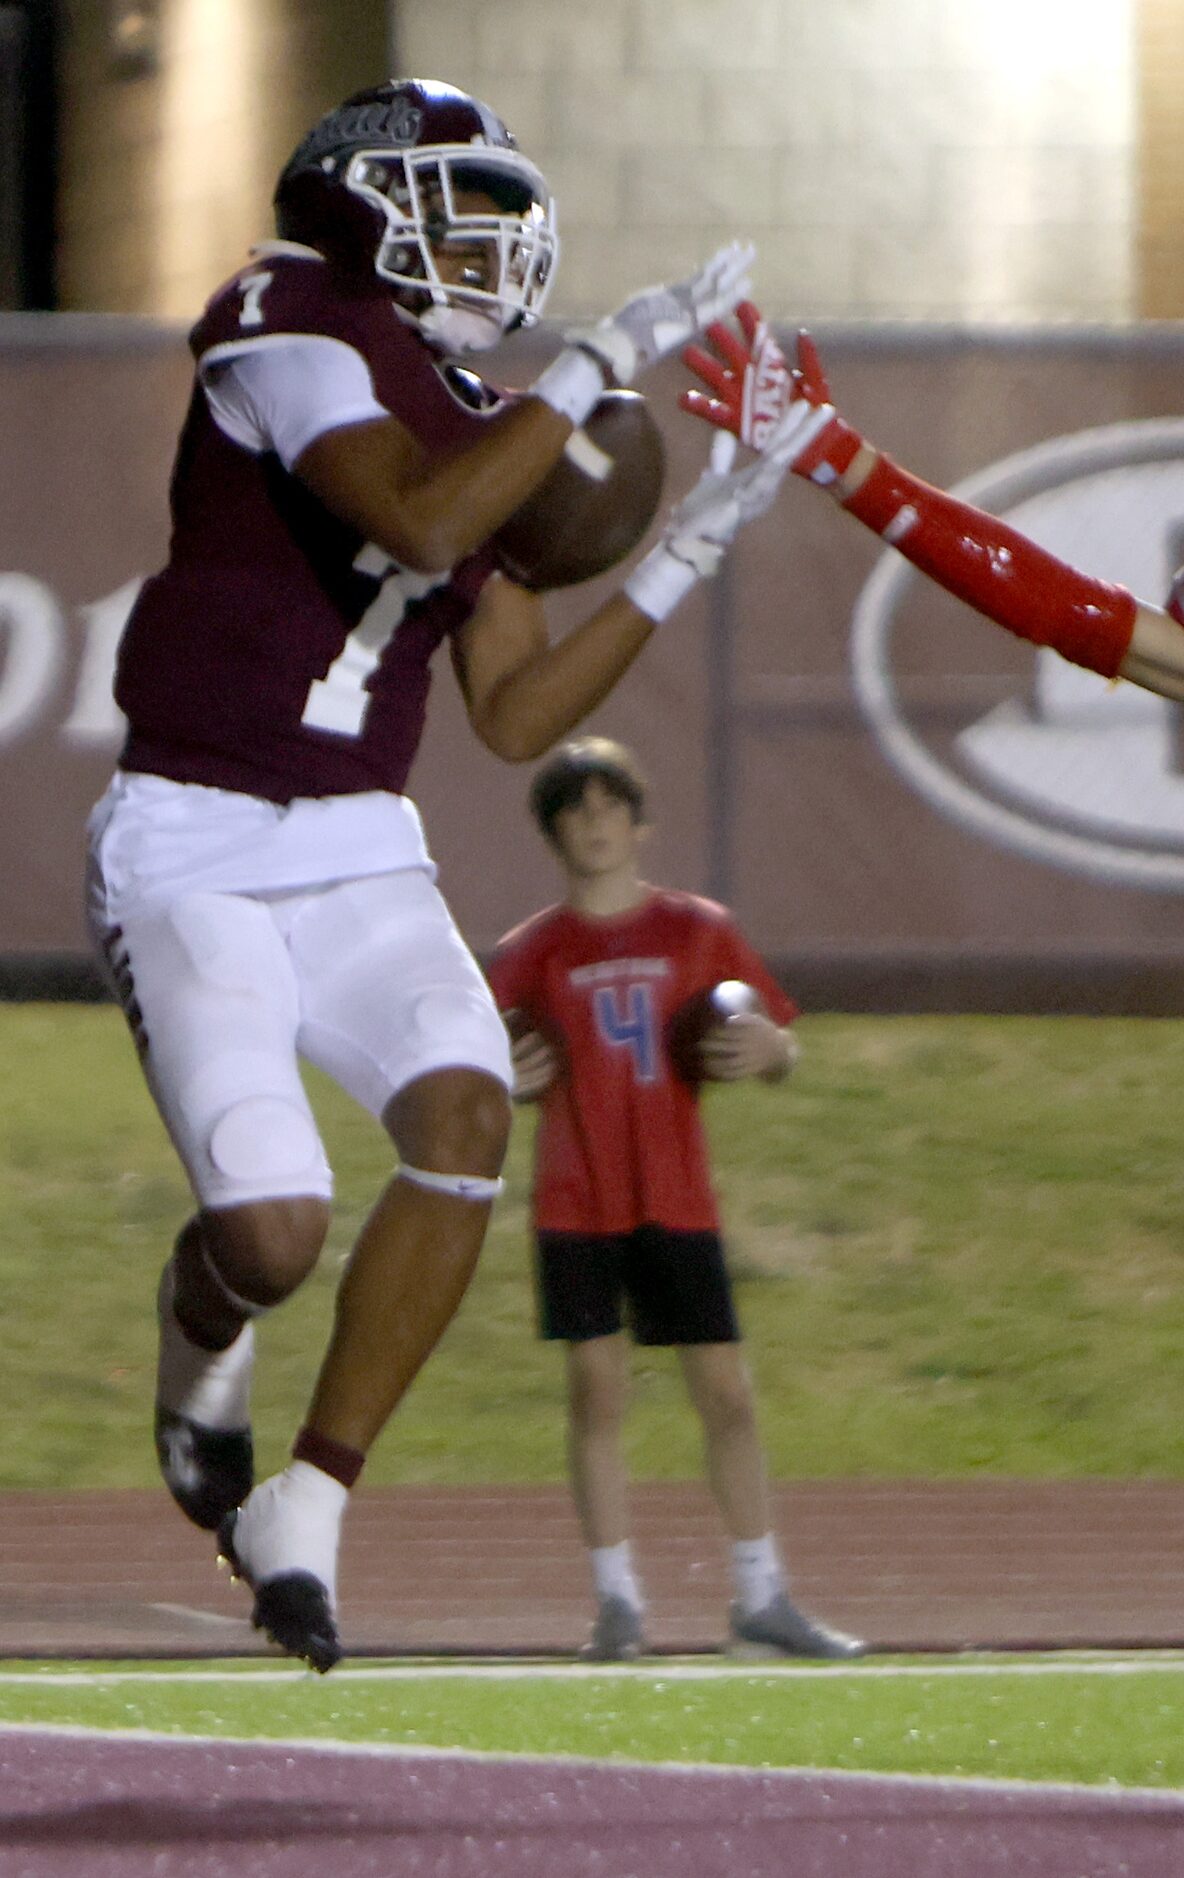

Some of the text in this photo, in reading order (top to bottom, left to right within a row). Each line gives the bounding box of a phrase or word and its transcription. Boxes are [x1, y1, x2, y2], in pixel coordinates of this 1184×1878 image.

[238, 271, 272, 326] 7
[301, 541, 451, 737] 7
[593, 980, 661, 1085] 4
